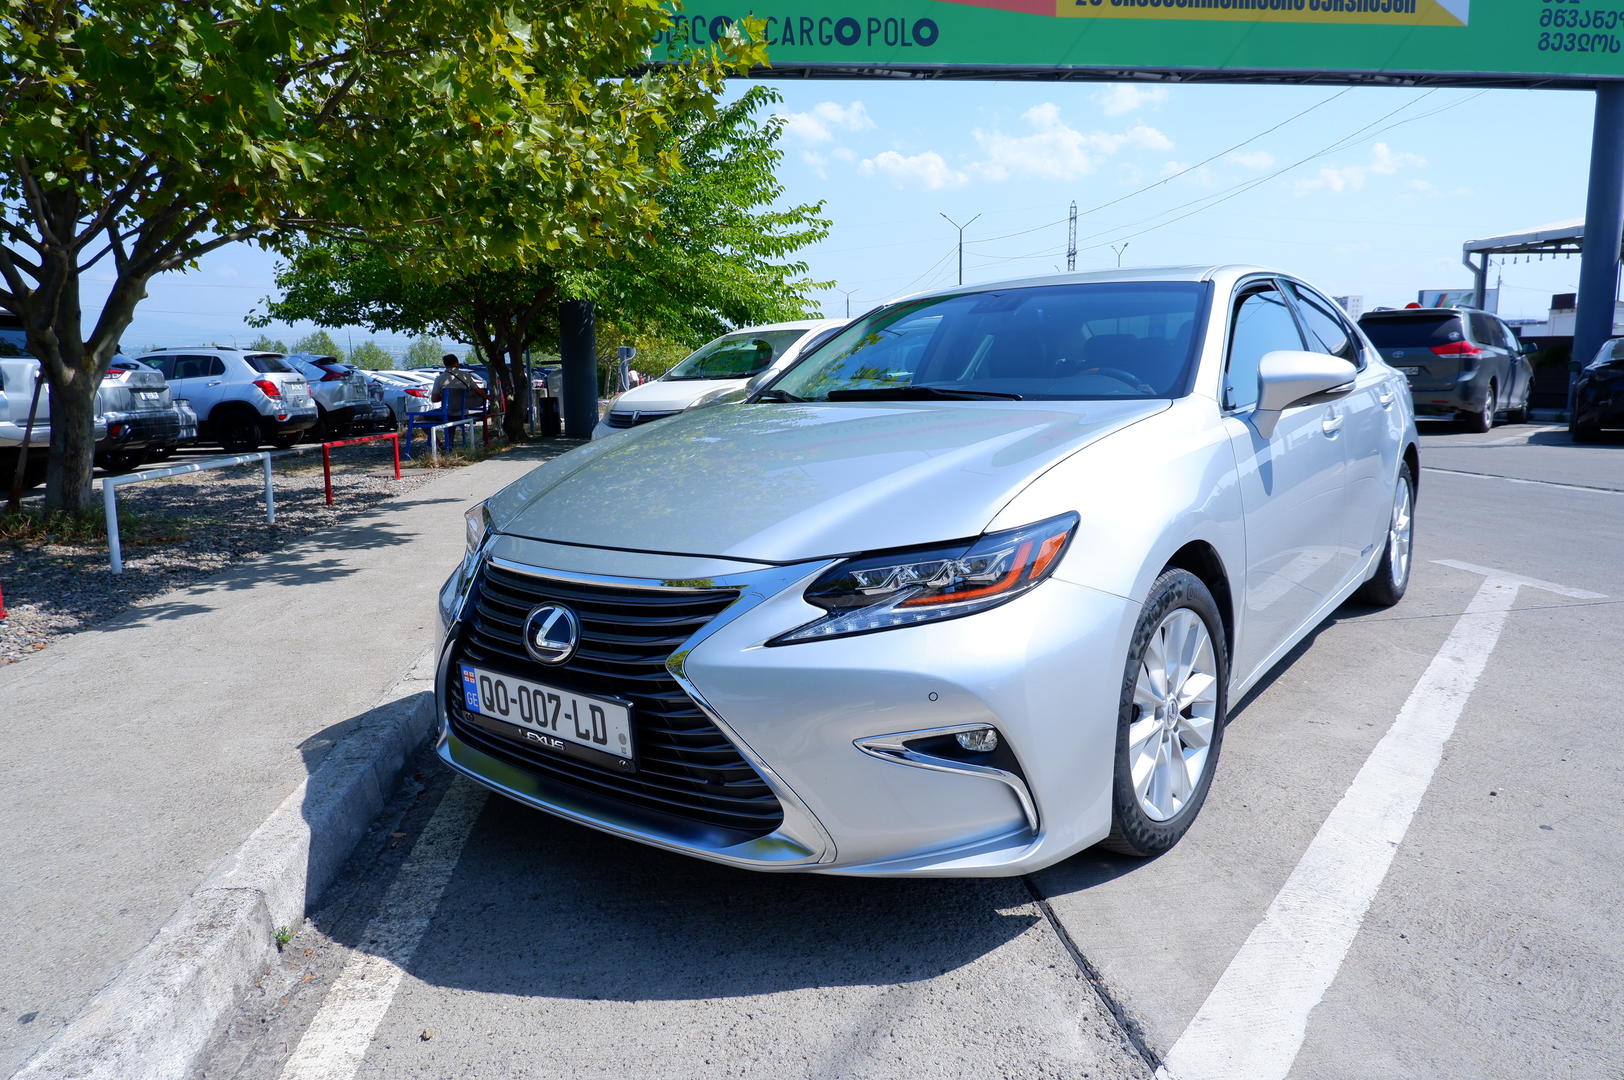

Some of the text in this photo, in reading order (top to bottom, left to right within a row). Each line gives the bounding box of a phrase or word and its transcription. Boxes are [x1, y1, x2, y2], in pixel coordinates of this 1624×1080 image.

[764, 16, 861, 46] CARGO
[867, 17, 939, 47] POLO
[466, 691, 479, 707] GE
